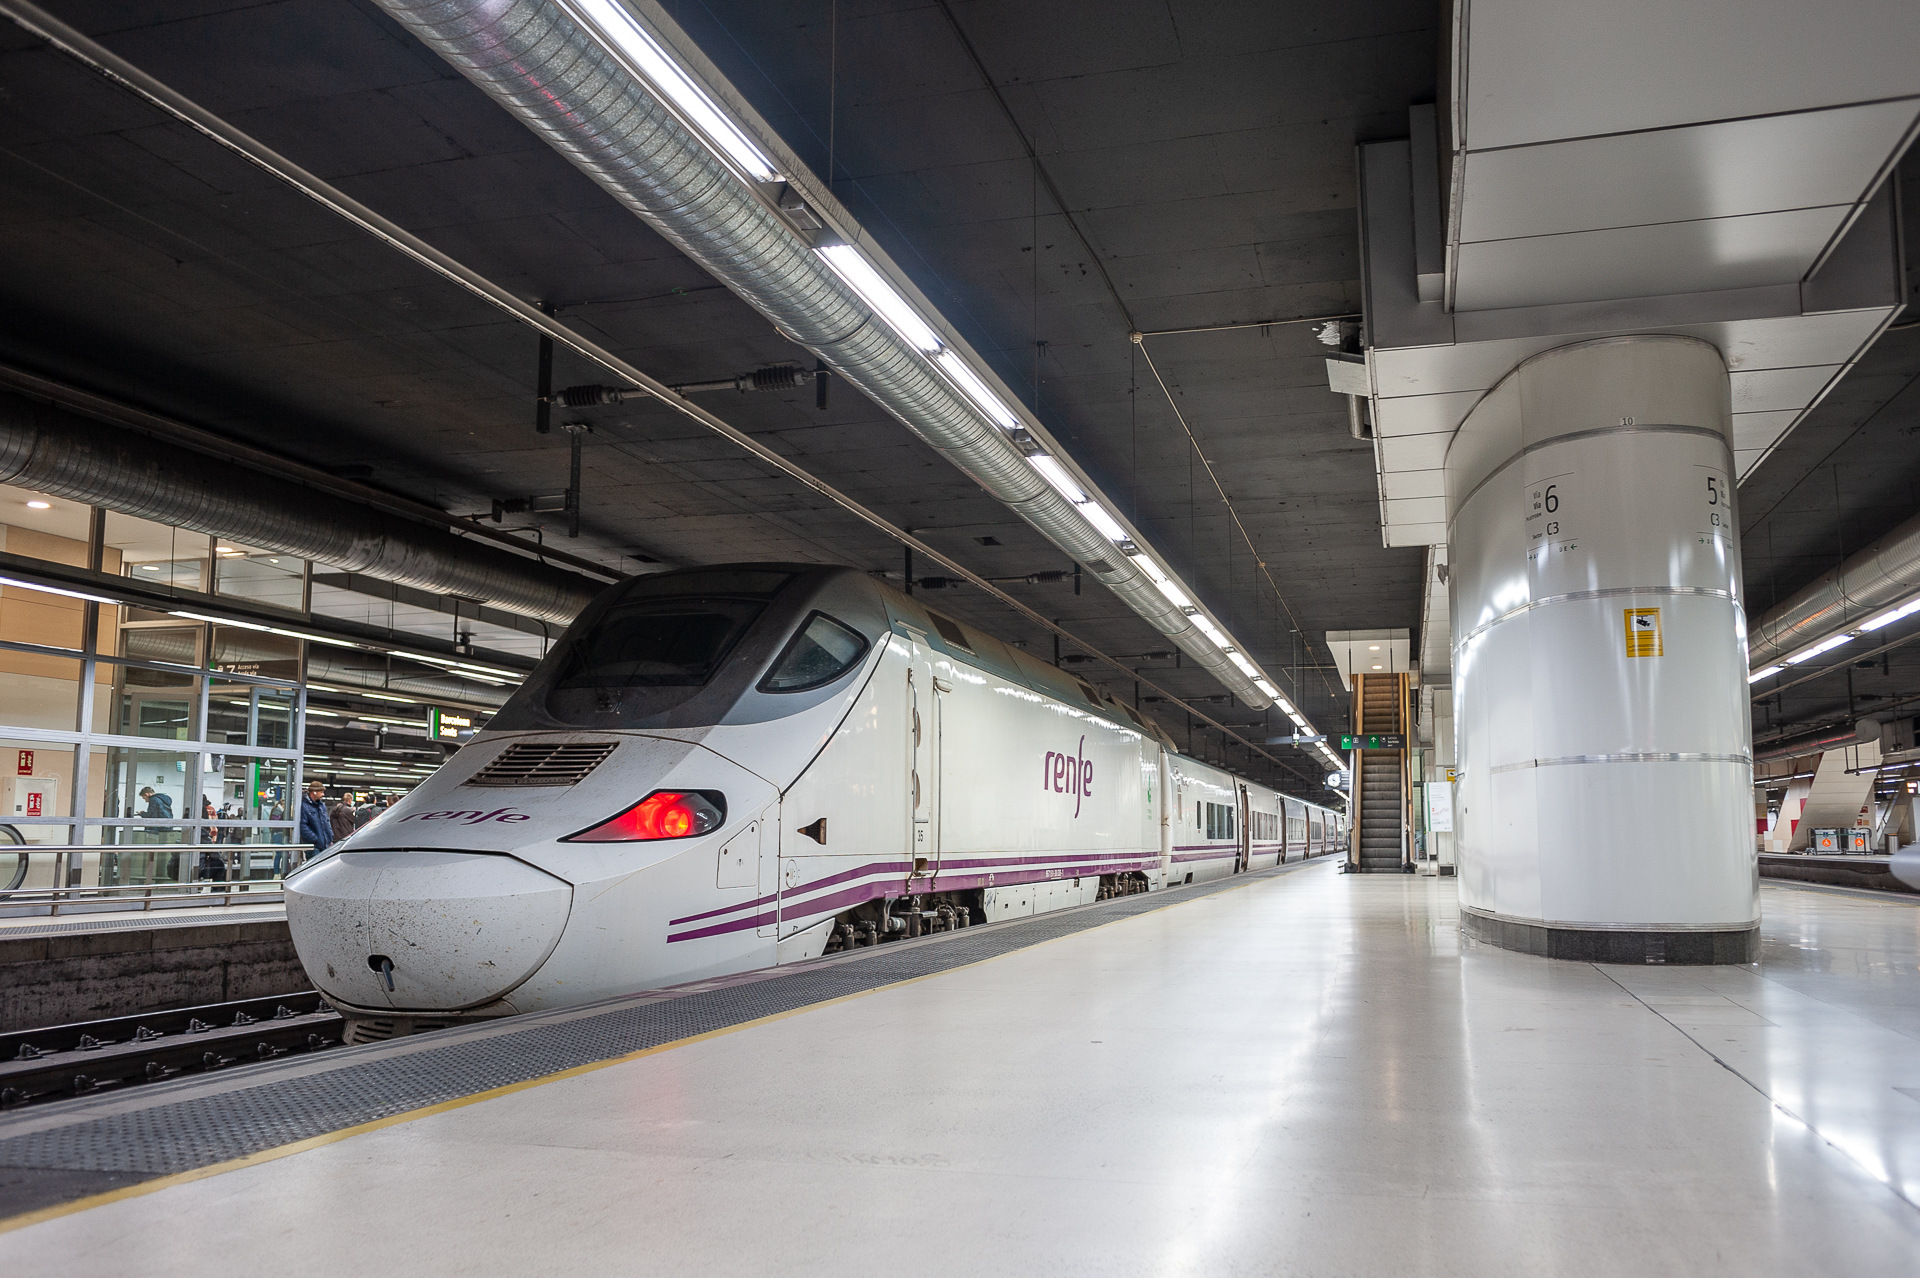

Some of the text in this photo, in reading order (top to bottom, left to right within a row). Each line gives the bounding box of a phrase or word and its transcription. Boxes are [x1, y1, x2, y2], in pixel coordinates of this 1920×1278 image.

[1622, 417, 1633, 426] 10
[1707, 476, 1718, 506] 5
[1545, 484, 1559, 513] 6
[1710, 512, 1720, 526] C3
[1546, 521, 1559, 535] C3
[440, 713, 471, 727] Barcelona
[440, 725, 458, 737] Sants
[1044, 735, 1093, 819] renfe
[397, 806, 531, 826] renfe
[917, 829, 924, 842] 35
